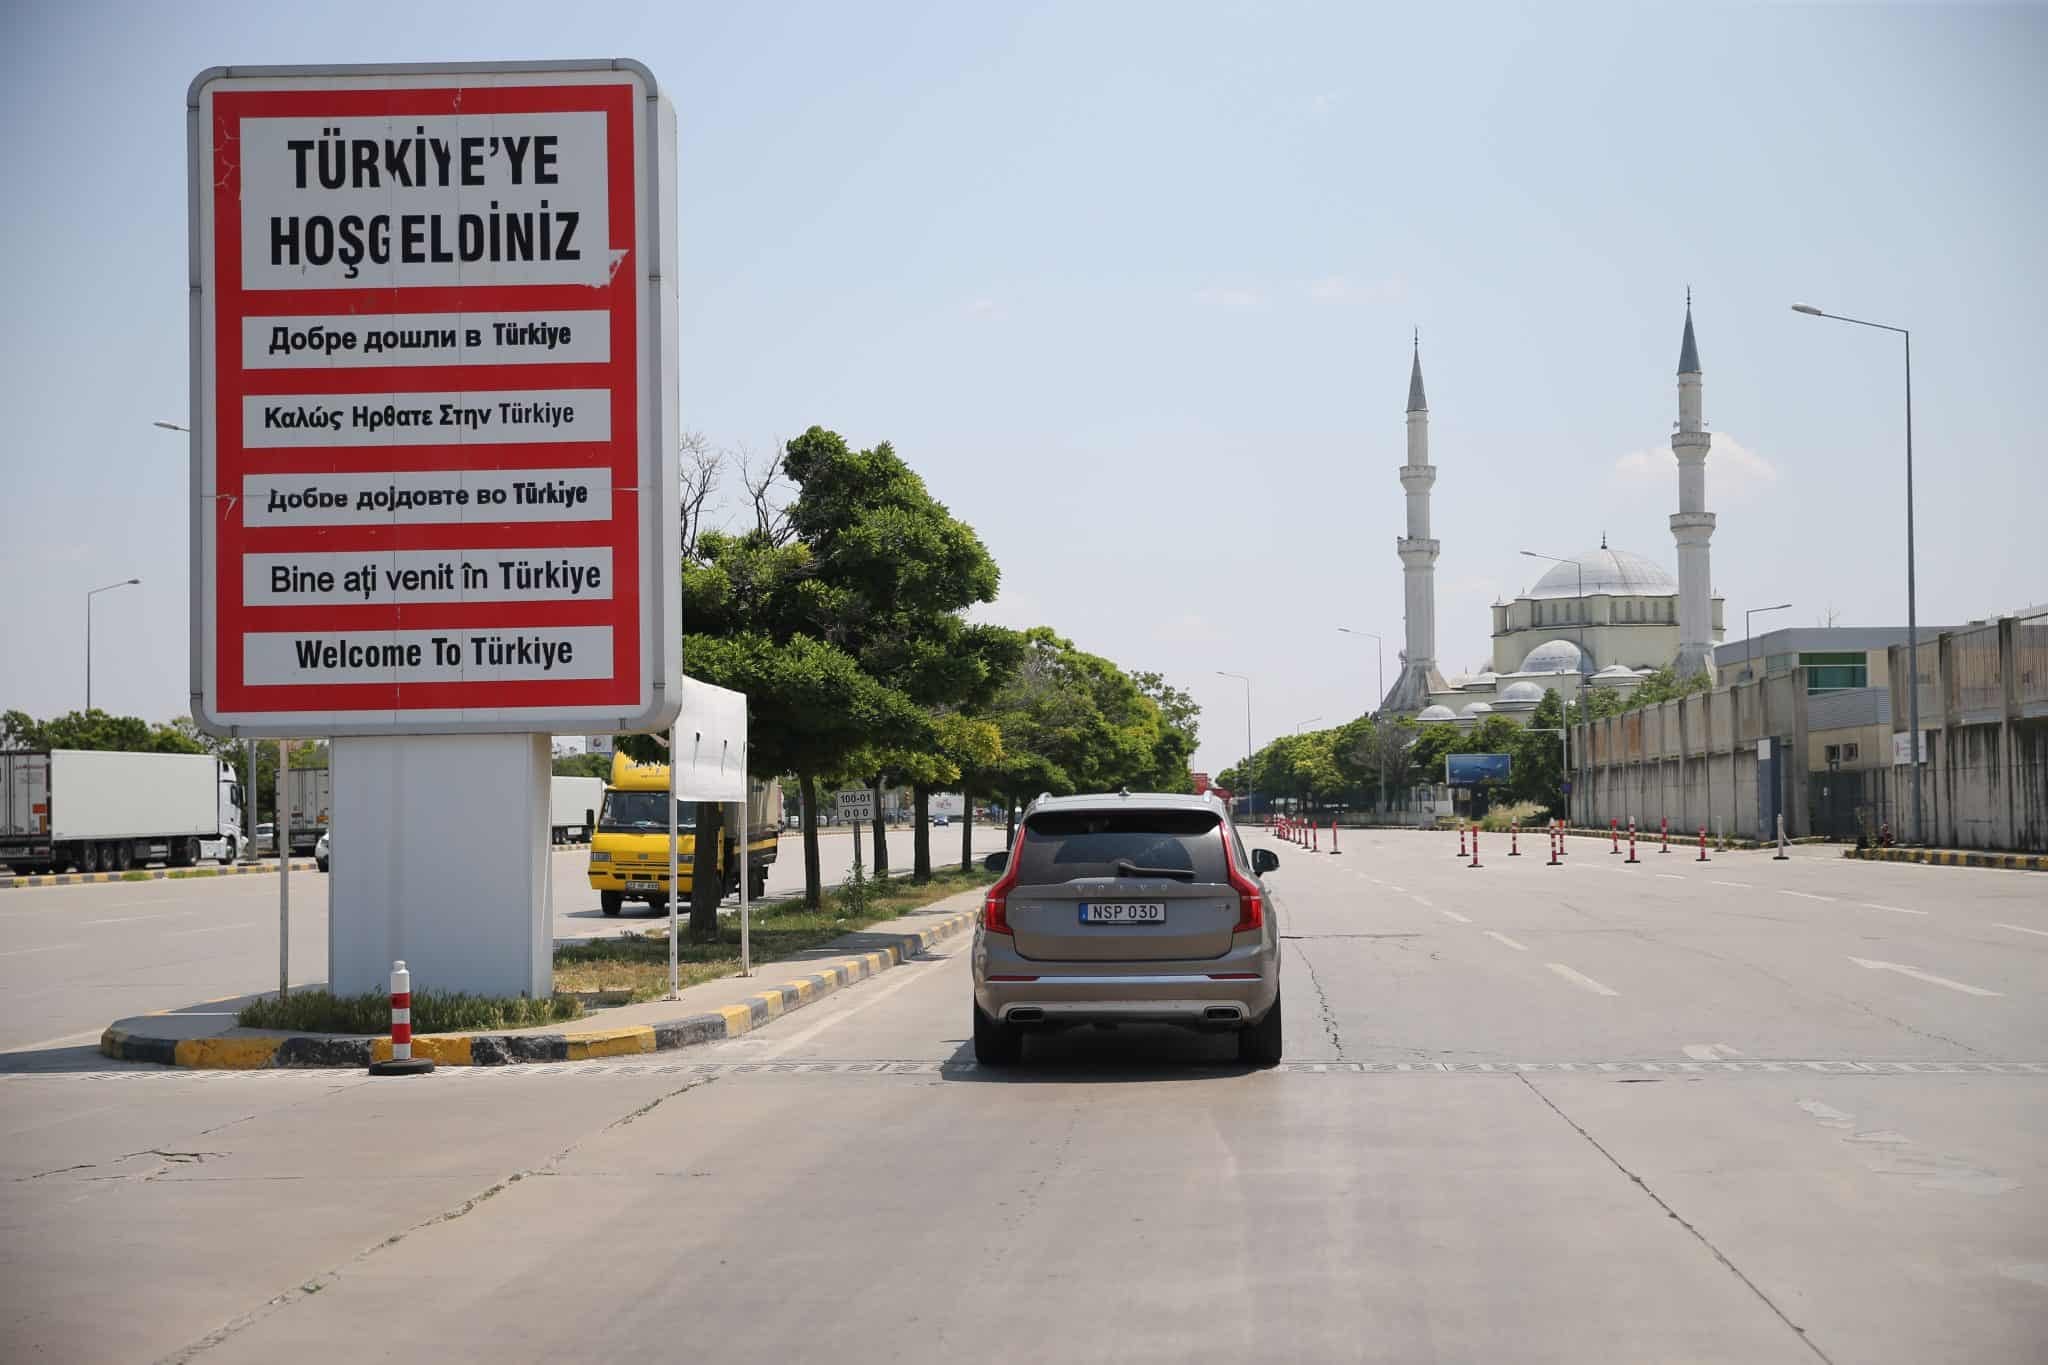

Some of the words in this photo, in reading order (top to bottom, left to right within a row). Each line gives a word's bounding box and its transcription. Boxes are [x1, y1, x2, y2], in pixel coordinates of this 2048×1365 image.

[287, 125, 559, 190] TÜRKİYE’YE
[270, 199, 581, 280] HOŞGELDİNİZ
[269, 325, 357, 356] Добре
[363, 329, 457, 354] дошли
[465, 329, 482, 348] в
[492, 321, 571, 350] Türkiye
[264, 405, 345, 431] Καλώς
[352, 404, 434, 433] Ηρθατε
[439, 403, 492, 430] Στην
[498, 401, 575, 428] Türkiye
[356, 485, 470, 512] дојдовте
[476, 488, 508, 505] во
[512, 480, 588, 509] Türkiye
[271, 565, 335, 593] Bine
[343, 564, 377, 601] ați
[386, 562, 455, 591] venit
[460, 561, 488, 590] în
[498, 559, 601, 595] Türkiye
[295, 639, 422, 669] Welcome
[431, 637, 461, 667] To
[470, 636, 573, 671] Türkiye
[1093, 905, 1122, 919] NSP
[1128, 905, 1158, 919] 03D
